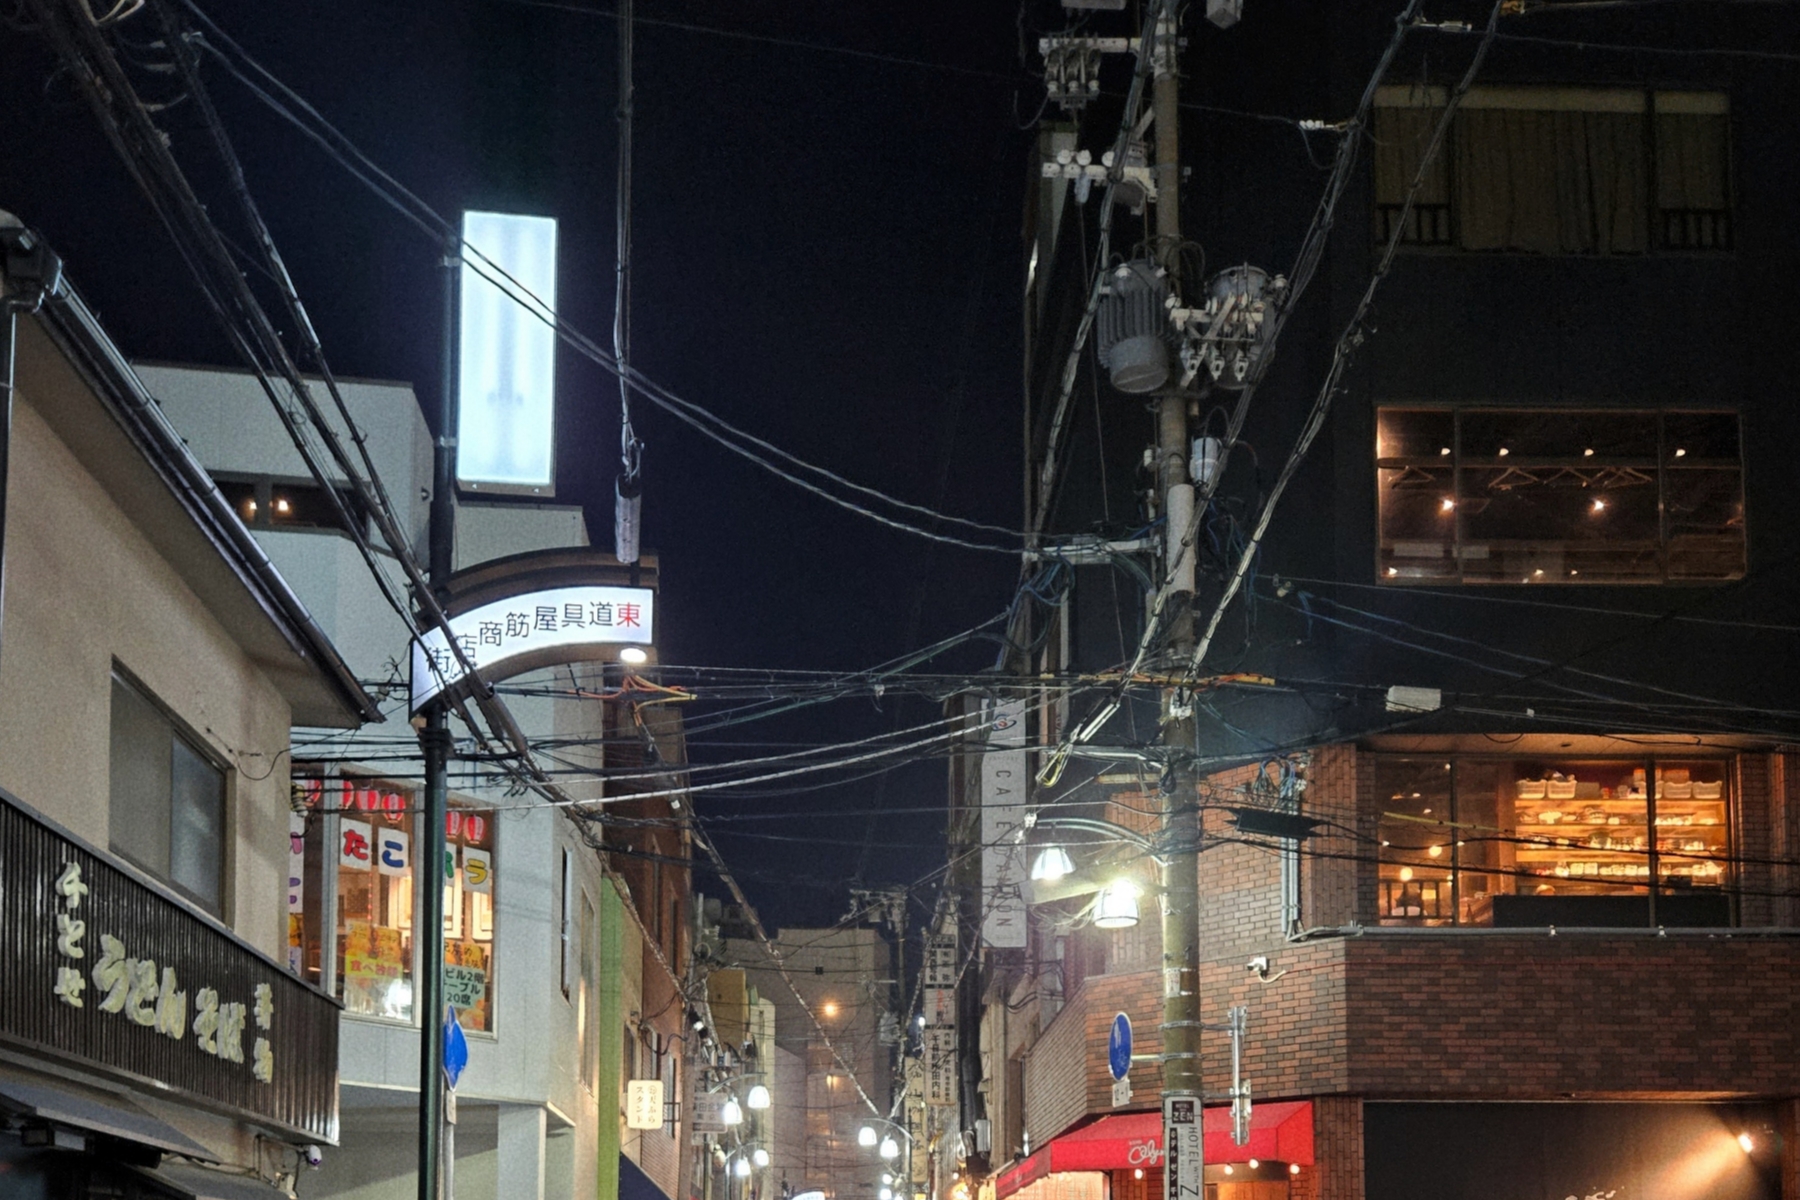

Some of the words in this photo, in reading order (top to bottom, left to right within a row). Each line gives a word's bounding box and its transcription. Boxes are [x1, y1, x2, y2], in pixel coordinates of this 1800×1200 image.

[92, 934, 186, 1040] うどん
[193, 986, 246, 1064] そば
[443, 981, 481, 995] ーブル
[636, 1086, 644, 1123] スタンド
[1173, 1111, 1193, 1121] ZEN
[1188, 1127, 1199, 1165] HOTEL
